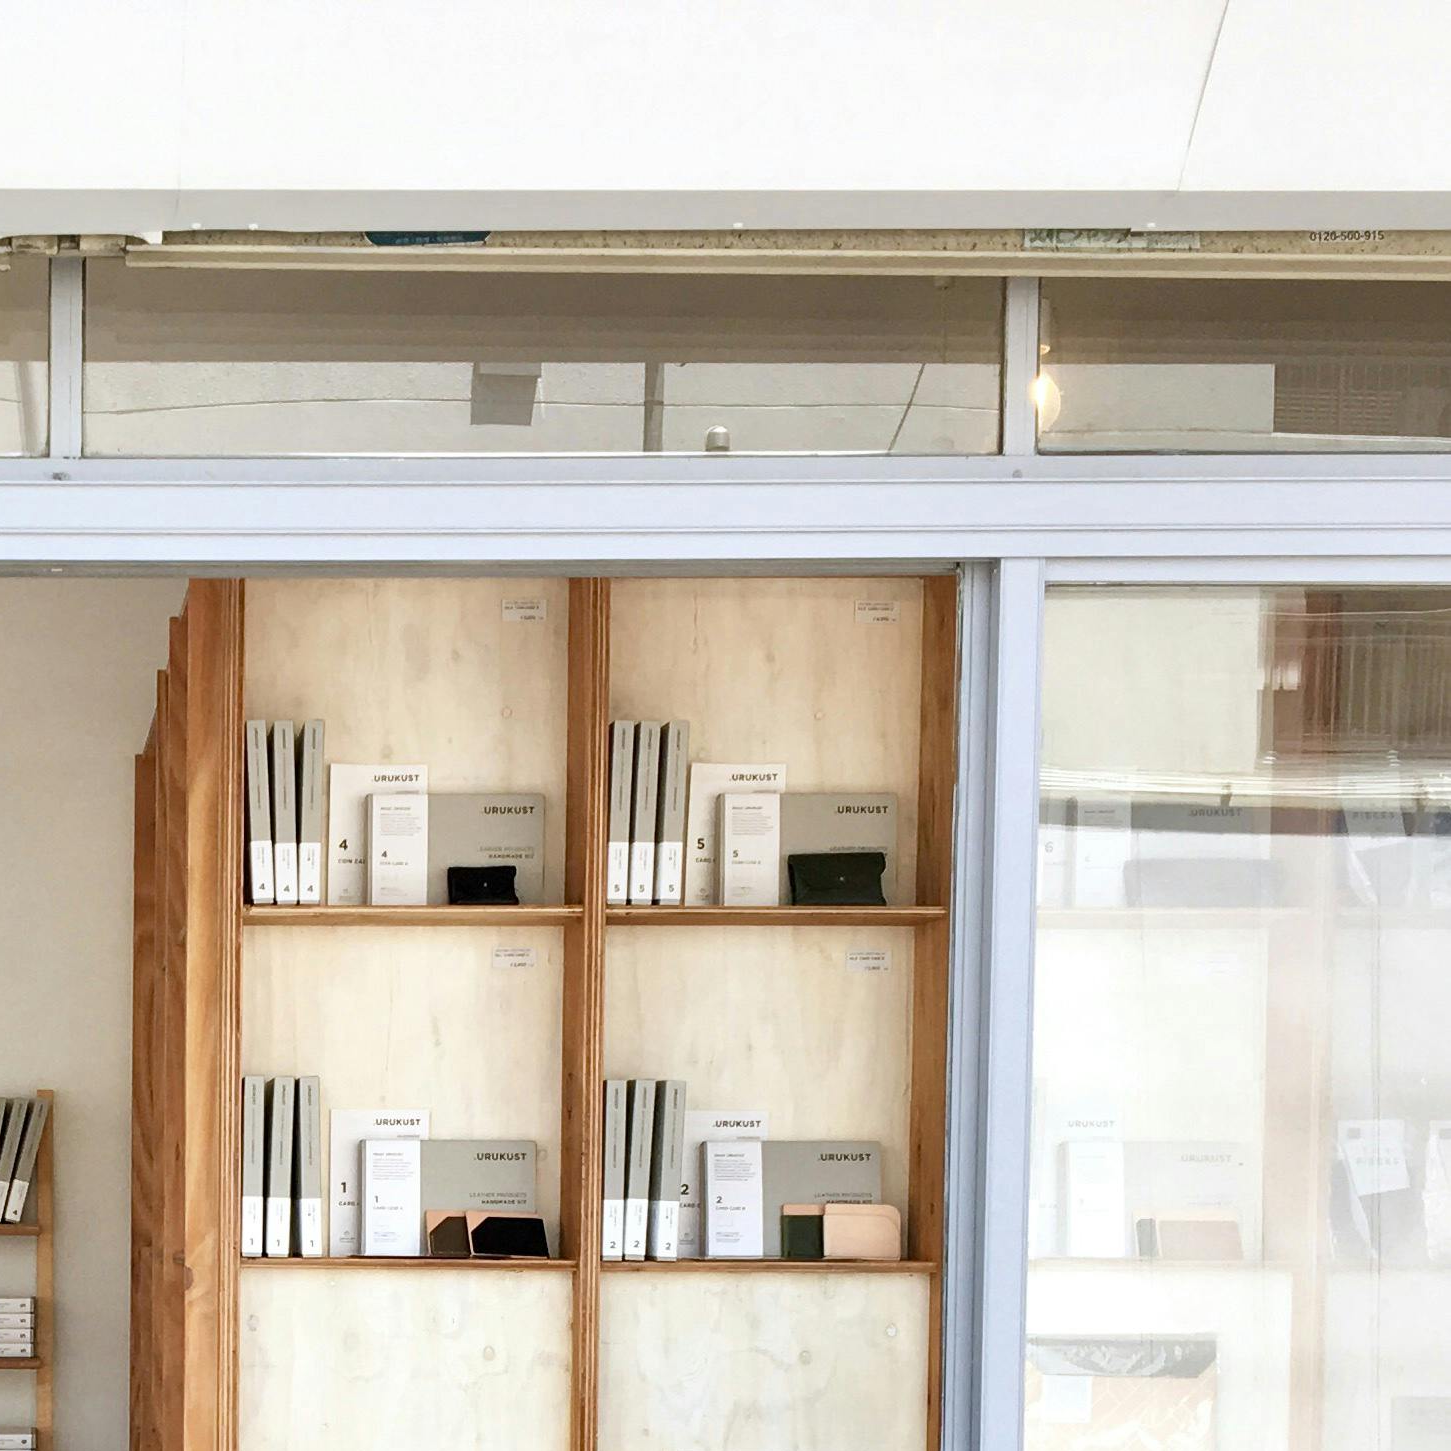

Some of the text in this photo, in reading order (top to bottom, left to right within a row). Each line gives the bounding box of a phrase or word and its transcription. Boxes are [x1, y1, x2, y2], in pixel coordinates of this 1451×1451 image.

[339, 838, 348, 850] 4
[697, 838, 705, 850] 5
[1045, 841, 1053, 853] 6
[381, 850, 387, 858] 4
[732, 850, 739, 858] 5
[340, 1182, 347, 1193] 1
[680, 1184, 689, 1195] 2
[716, 1196, 723, 1204] 2
[610, 1241, 616, 1249] 2
[633, 1240, 640, 1248] 2
